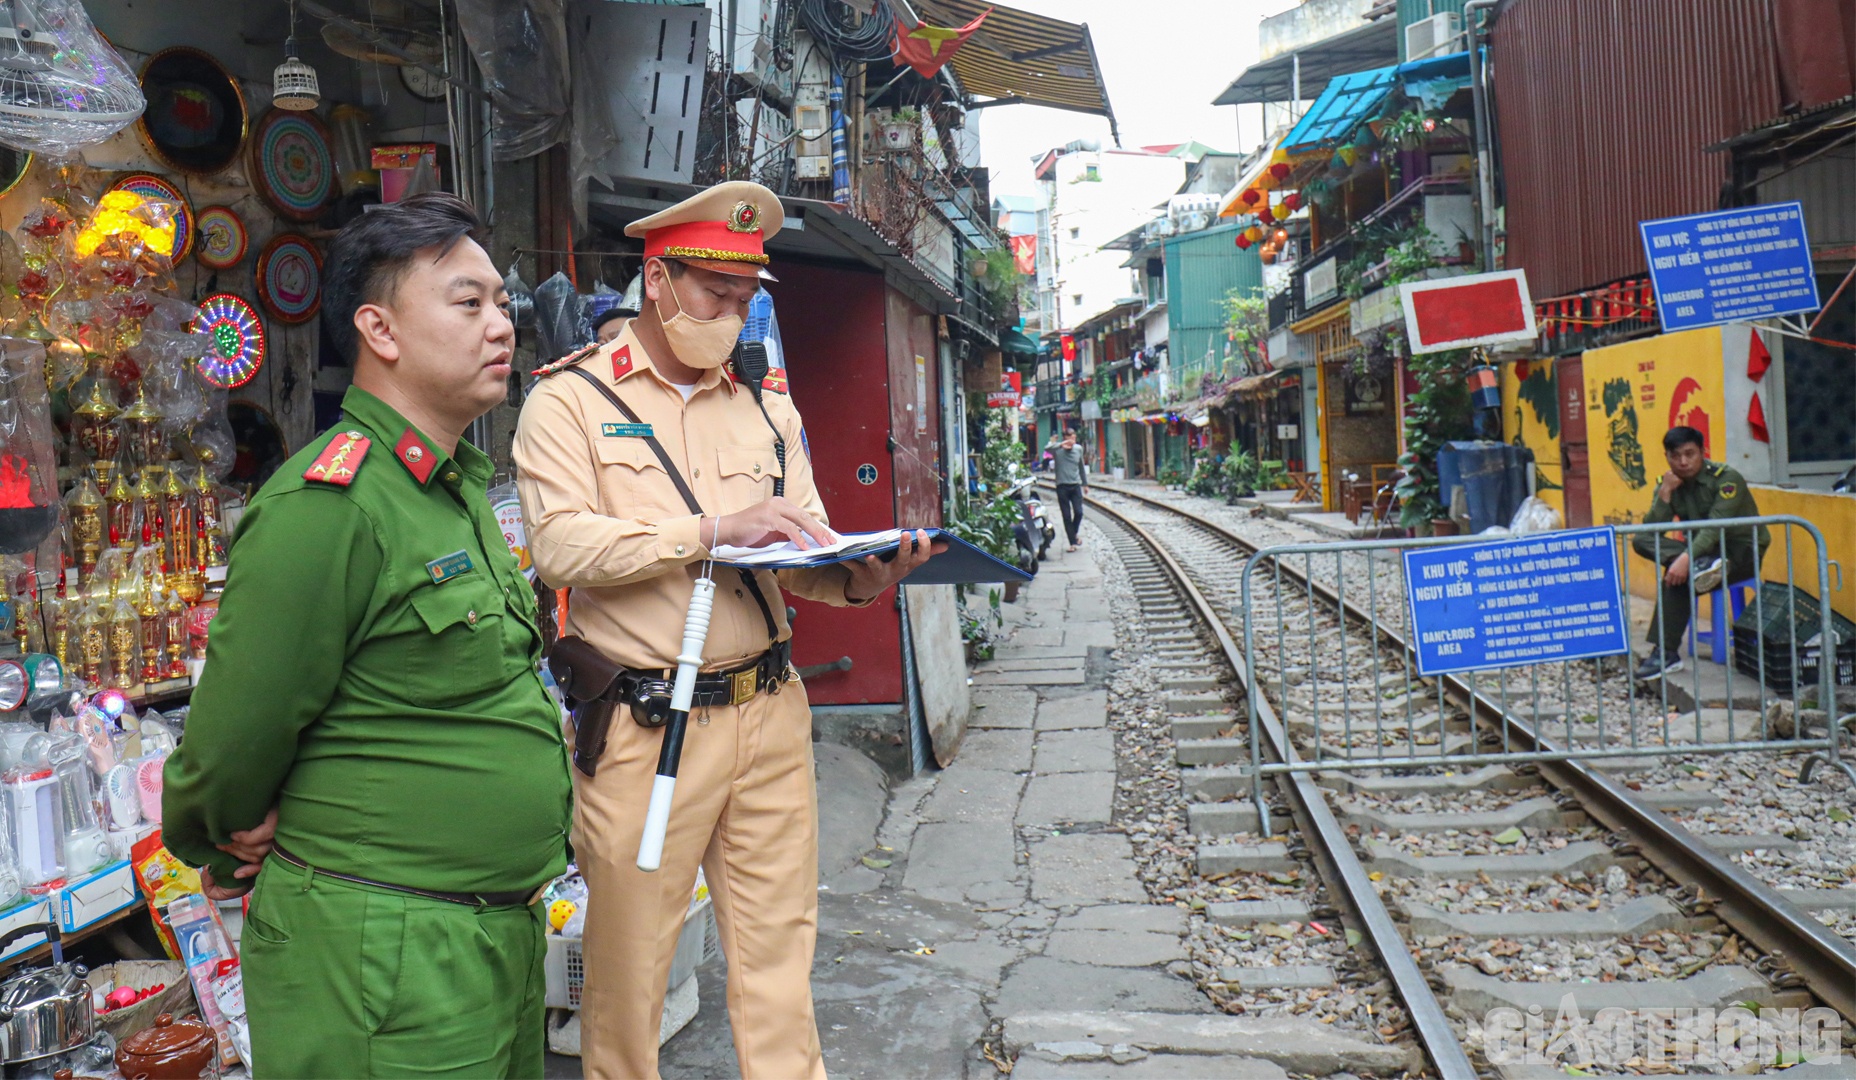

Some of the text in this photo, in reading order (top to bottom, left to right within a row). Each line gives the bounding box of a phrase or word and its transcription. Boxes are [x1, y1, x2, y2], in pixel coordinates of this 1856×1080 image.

[1653, 231, 1690, 249] KHU VỰC
[1653, 247, 1701, 270] NGUY HIỂM
[1662, 288, 1705, 304] DANGEROUS
[1676, 305, 1695, 318] AREA
[1474, 549, 1494, 562] KHÔNG
[1501, 546, 1512, 560] TẬP
[1512, 544, 1529, 557] ĐÔNG
[1547, 541, 1562, 553] QUAY
[1579, 537, 1594, 550] CHỤP
[1594, 532, 1607, 547] ẢNH
[1422, 560, 1469, 580] KHU VỰC
[1476, 565, 1496, 578] KHÔNG
[1535, 557, 1550, 570] TRÊN
[1549, 555, 1569, 569] ĐƯỜNG
[1569, 553, 1580, 566] SẮT
[1415, 577, 1473, 602] NGUY HIỂM
[1478, 581, 1498, 594] KHÔNG
[1570, 570, 1589, 582] TRONG
[1508, 593, 1528, 606] ĐƯỜNG
[1528, 591, 1539, 604] SẮT
[1483, 614, 1492, 624] DO
[1492, 613, 1503, 623] NOT
[1503, 610, 1525, 621] GATHER
[1552, 605, 1566, 616] TAKE
[1566, 603, 1589, 614] PHOTOS,
[1589, 600, 1609, 611] VIDEOS
[1485, 626, 1493, 636] DO
[1493, 625, 1505, 635] NOT
[1552, 618, 1562, 628] ON
[1561, 615, 1588, 627] RAILROAD
[1588, 612, 1610, 623] TRACKS
[1495, 637, 1507, 647] NOT
[1507, 635, 1530, 646] DISPLAY
[1552, 630, 1573, 640] TABLES
[1572, 628, 1585, 638] AND
[1605, 624, 1615, 634] ON
[1437, 642, 1462, 656] AREA
[1485, 643, 1564, 661] AND ALONG RAILROAD TRACKS
